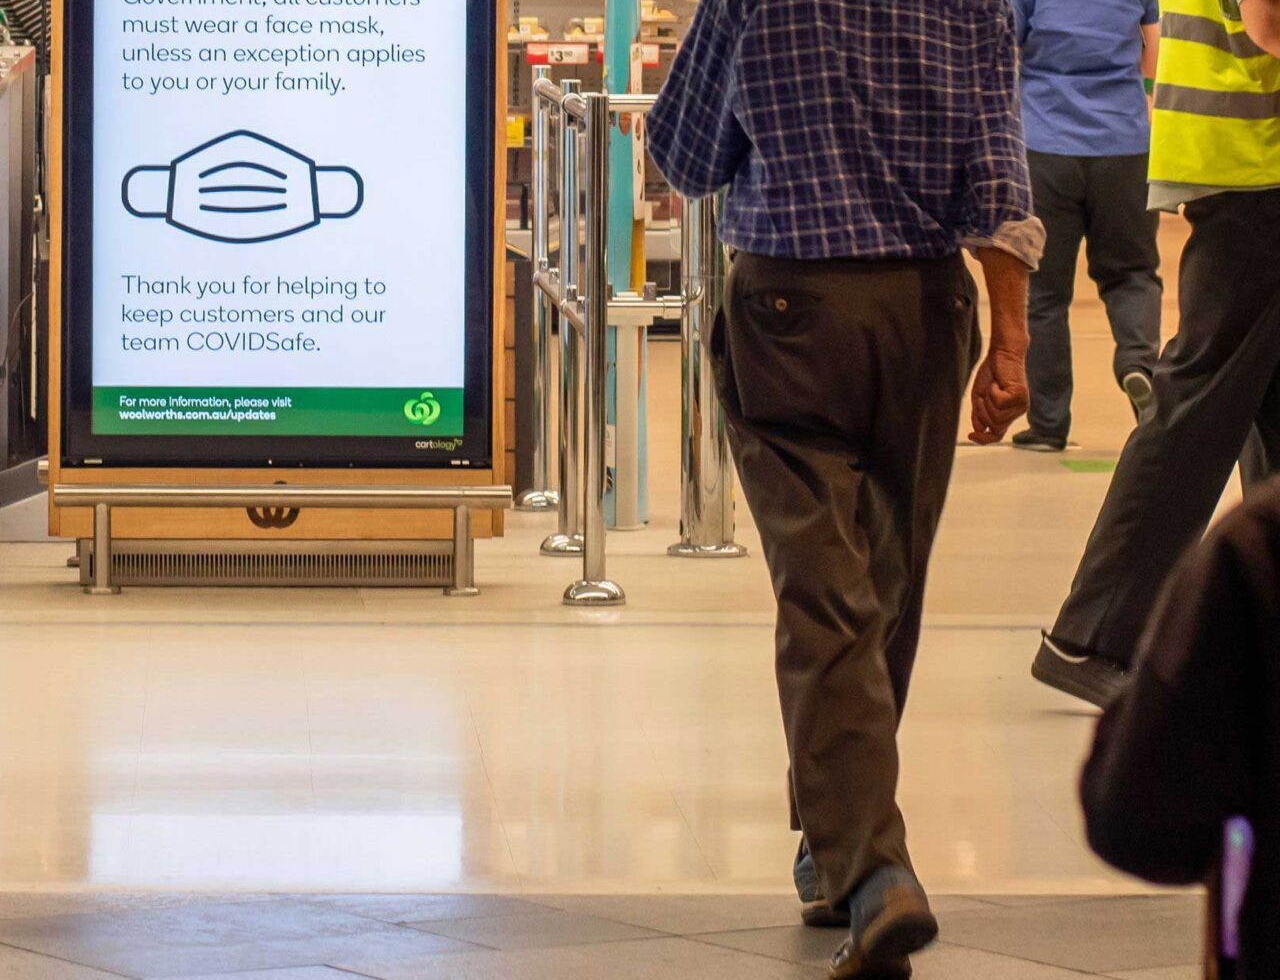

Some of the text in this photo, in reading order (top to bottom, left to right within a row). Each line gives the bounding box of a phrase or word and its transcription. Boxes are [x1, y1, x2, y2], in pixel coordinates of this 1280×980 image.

[122, 14, 385, 37] must wear a face mask,
[122, 44, 426, 67] unless an exception applies
[122, 72, 346, 95] to you or your family.
[121, 275, 387, 299] Thank you for helping to
[121, 304, 386, 327] keep customers and our
[121, 331, 321, 352] team COVIDSafe.
[120, 396, 292, 411] For more information, please visit
[119, 409, 276, 422] woolworths.com.au/updates
